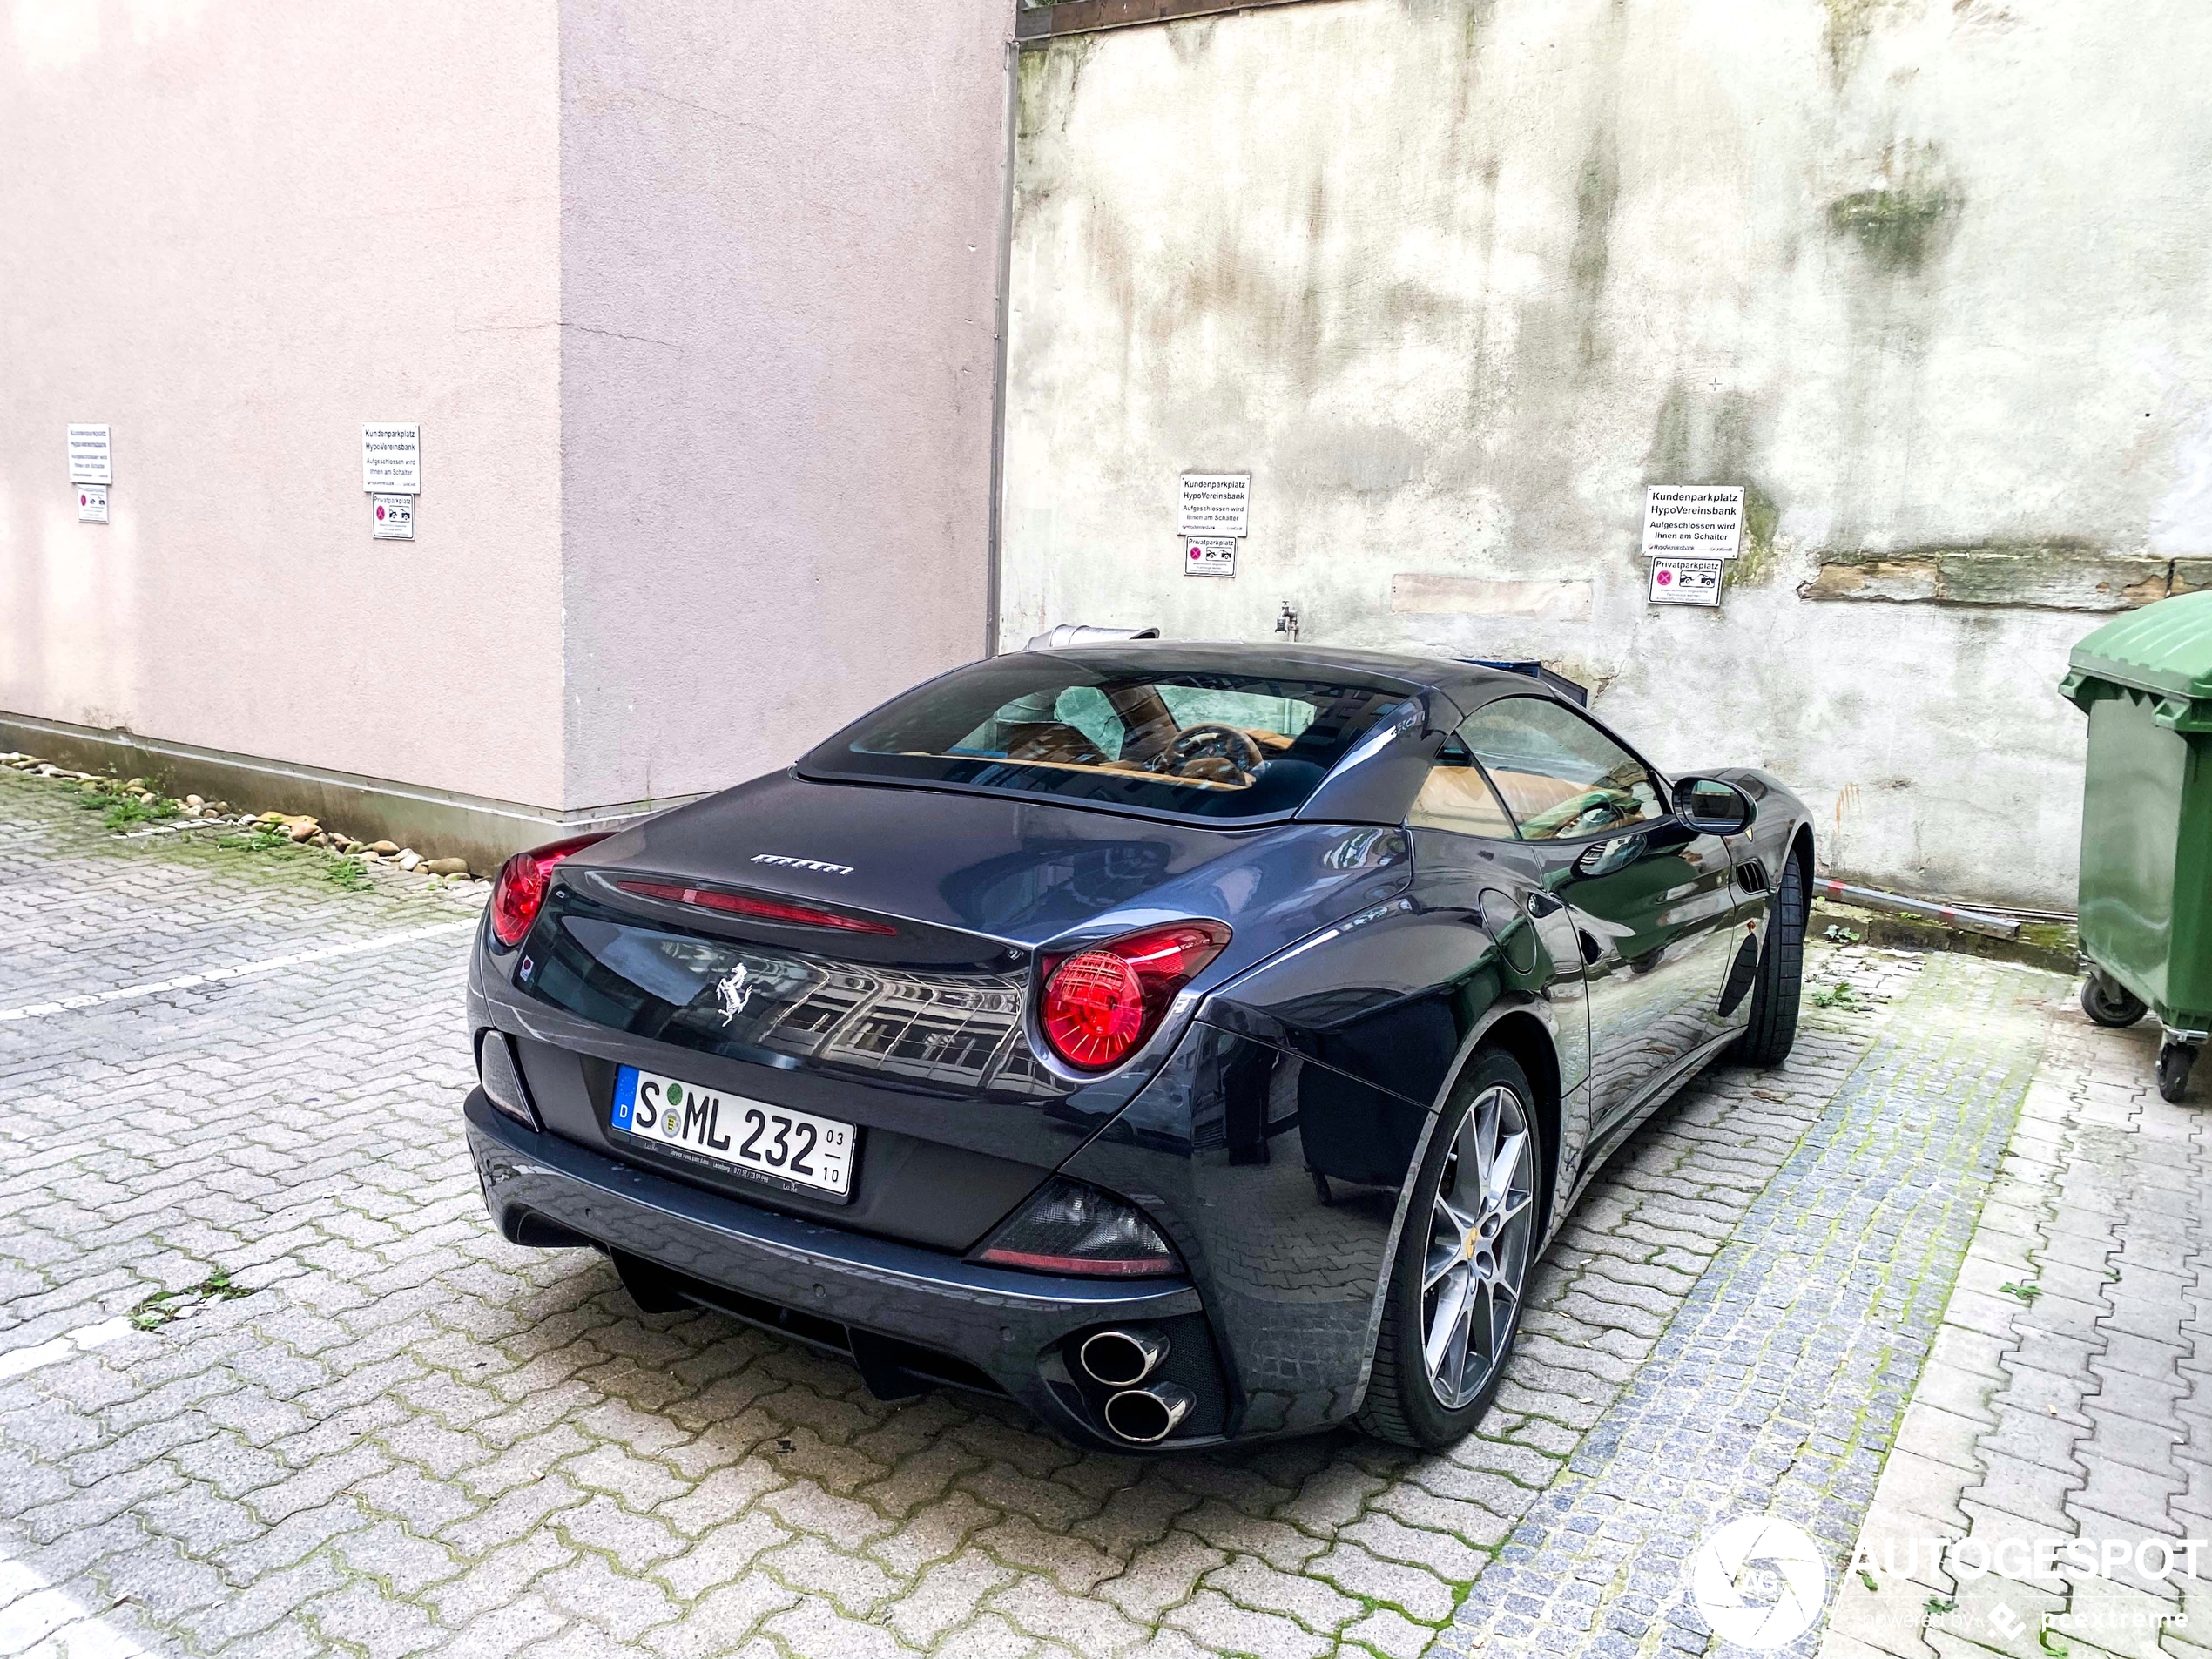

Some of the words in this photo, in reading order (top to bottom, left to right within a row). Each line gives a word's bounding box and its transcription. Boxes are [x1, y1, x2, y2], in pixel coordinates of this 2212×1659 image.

[365, 429, 415, 438] Kundenparkplatz
[366, 443, 415, 452] HypoVereinsbank
[1184, 481, 1245, 489] Kundenparkplatz
[1184, 492, 1244, 501] HypoVereinsbank
[1652, 492, 1738, 503] Kundenparkplatz
[1650, 505, 1737, 516] HypoVereinsbank
[1649, 521, 1715, 529] Aufgeschlossen
[1656, 560, 1719, 570] Privatparkplatz
[619, 1104, 628, 1118] D
[636, 1082, 660, 1128] S
[682, 1092, 731, 1151] ML
[739, 1109, 818, 1176] 232
[826, 1130, 843, 1146] 03
[823, 1167, 840, 1183] 10
